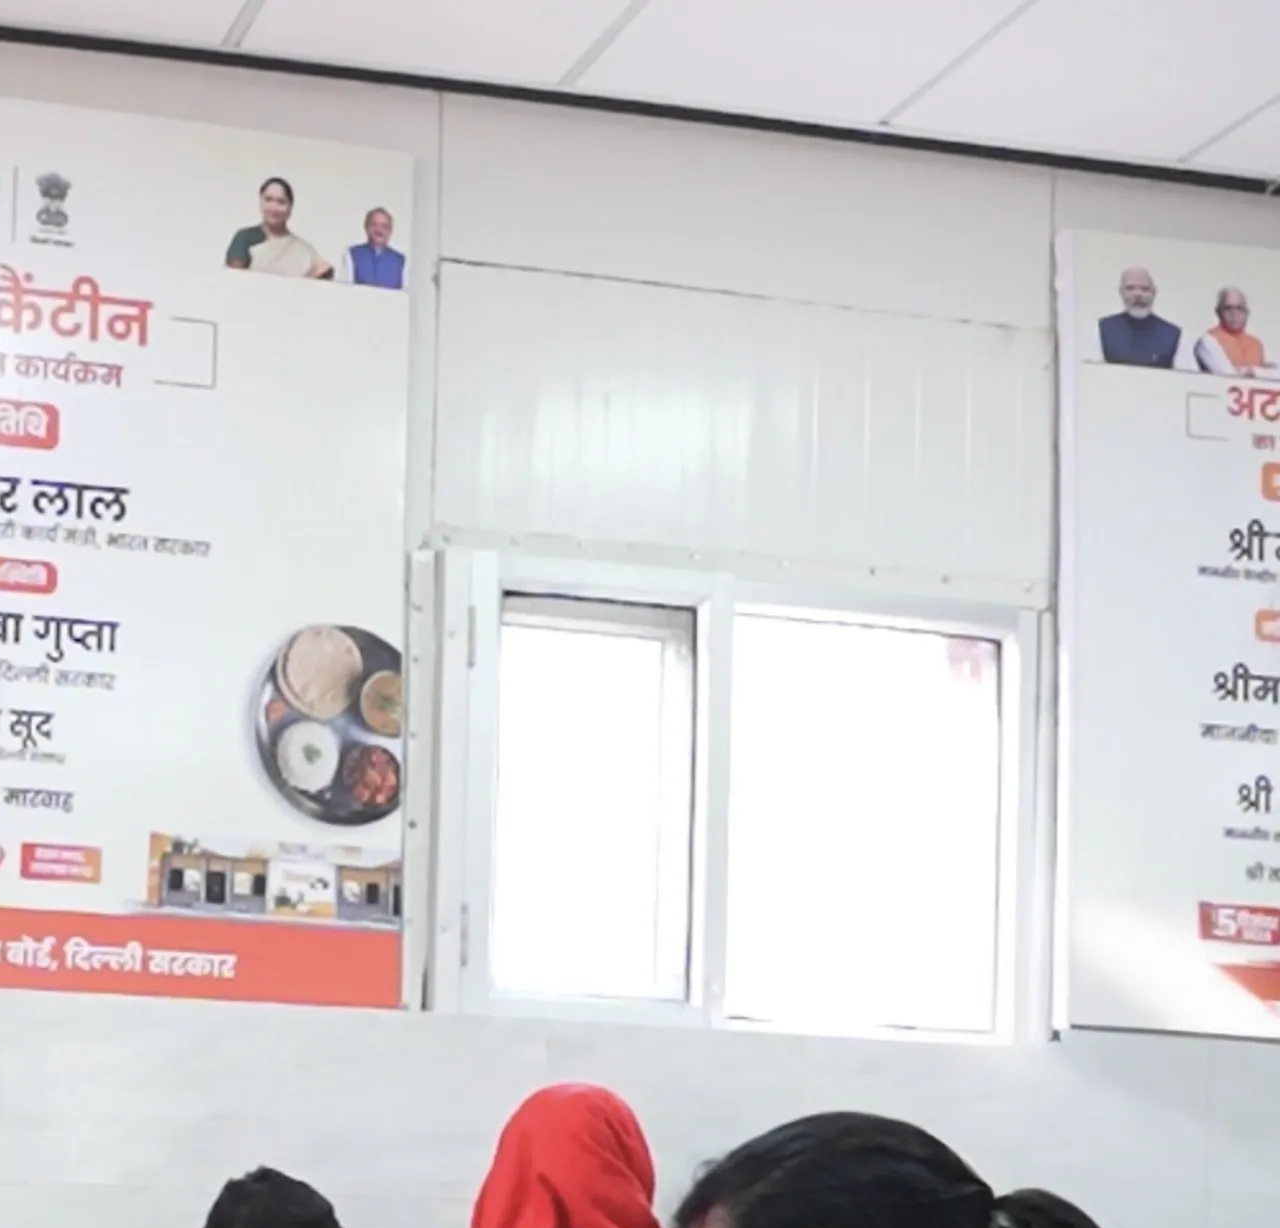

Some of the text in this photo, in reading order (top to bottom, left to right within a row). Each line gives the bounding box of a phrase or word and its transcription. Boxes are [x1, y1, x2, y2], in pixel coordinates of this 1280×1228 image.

[13, 351, 124, 388] कार्यक्रम
[1226, 385, 1280, 423] अट
[31, 478, 131, 522] लाल
[32, 614, 121, 663] गुप्ता
[1211, 661, 1280, 705] श्रीम
[8, 707, 56, 750] सूद
[1237, 773, 1272, 813] श्री
[63, 935, 144, 973] दिल्ली
[148, 950, 238, 979] सरकार
